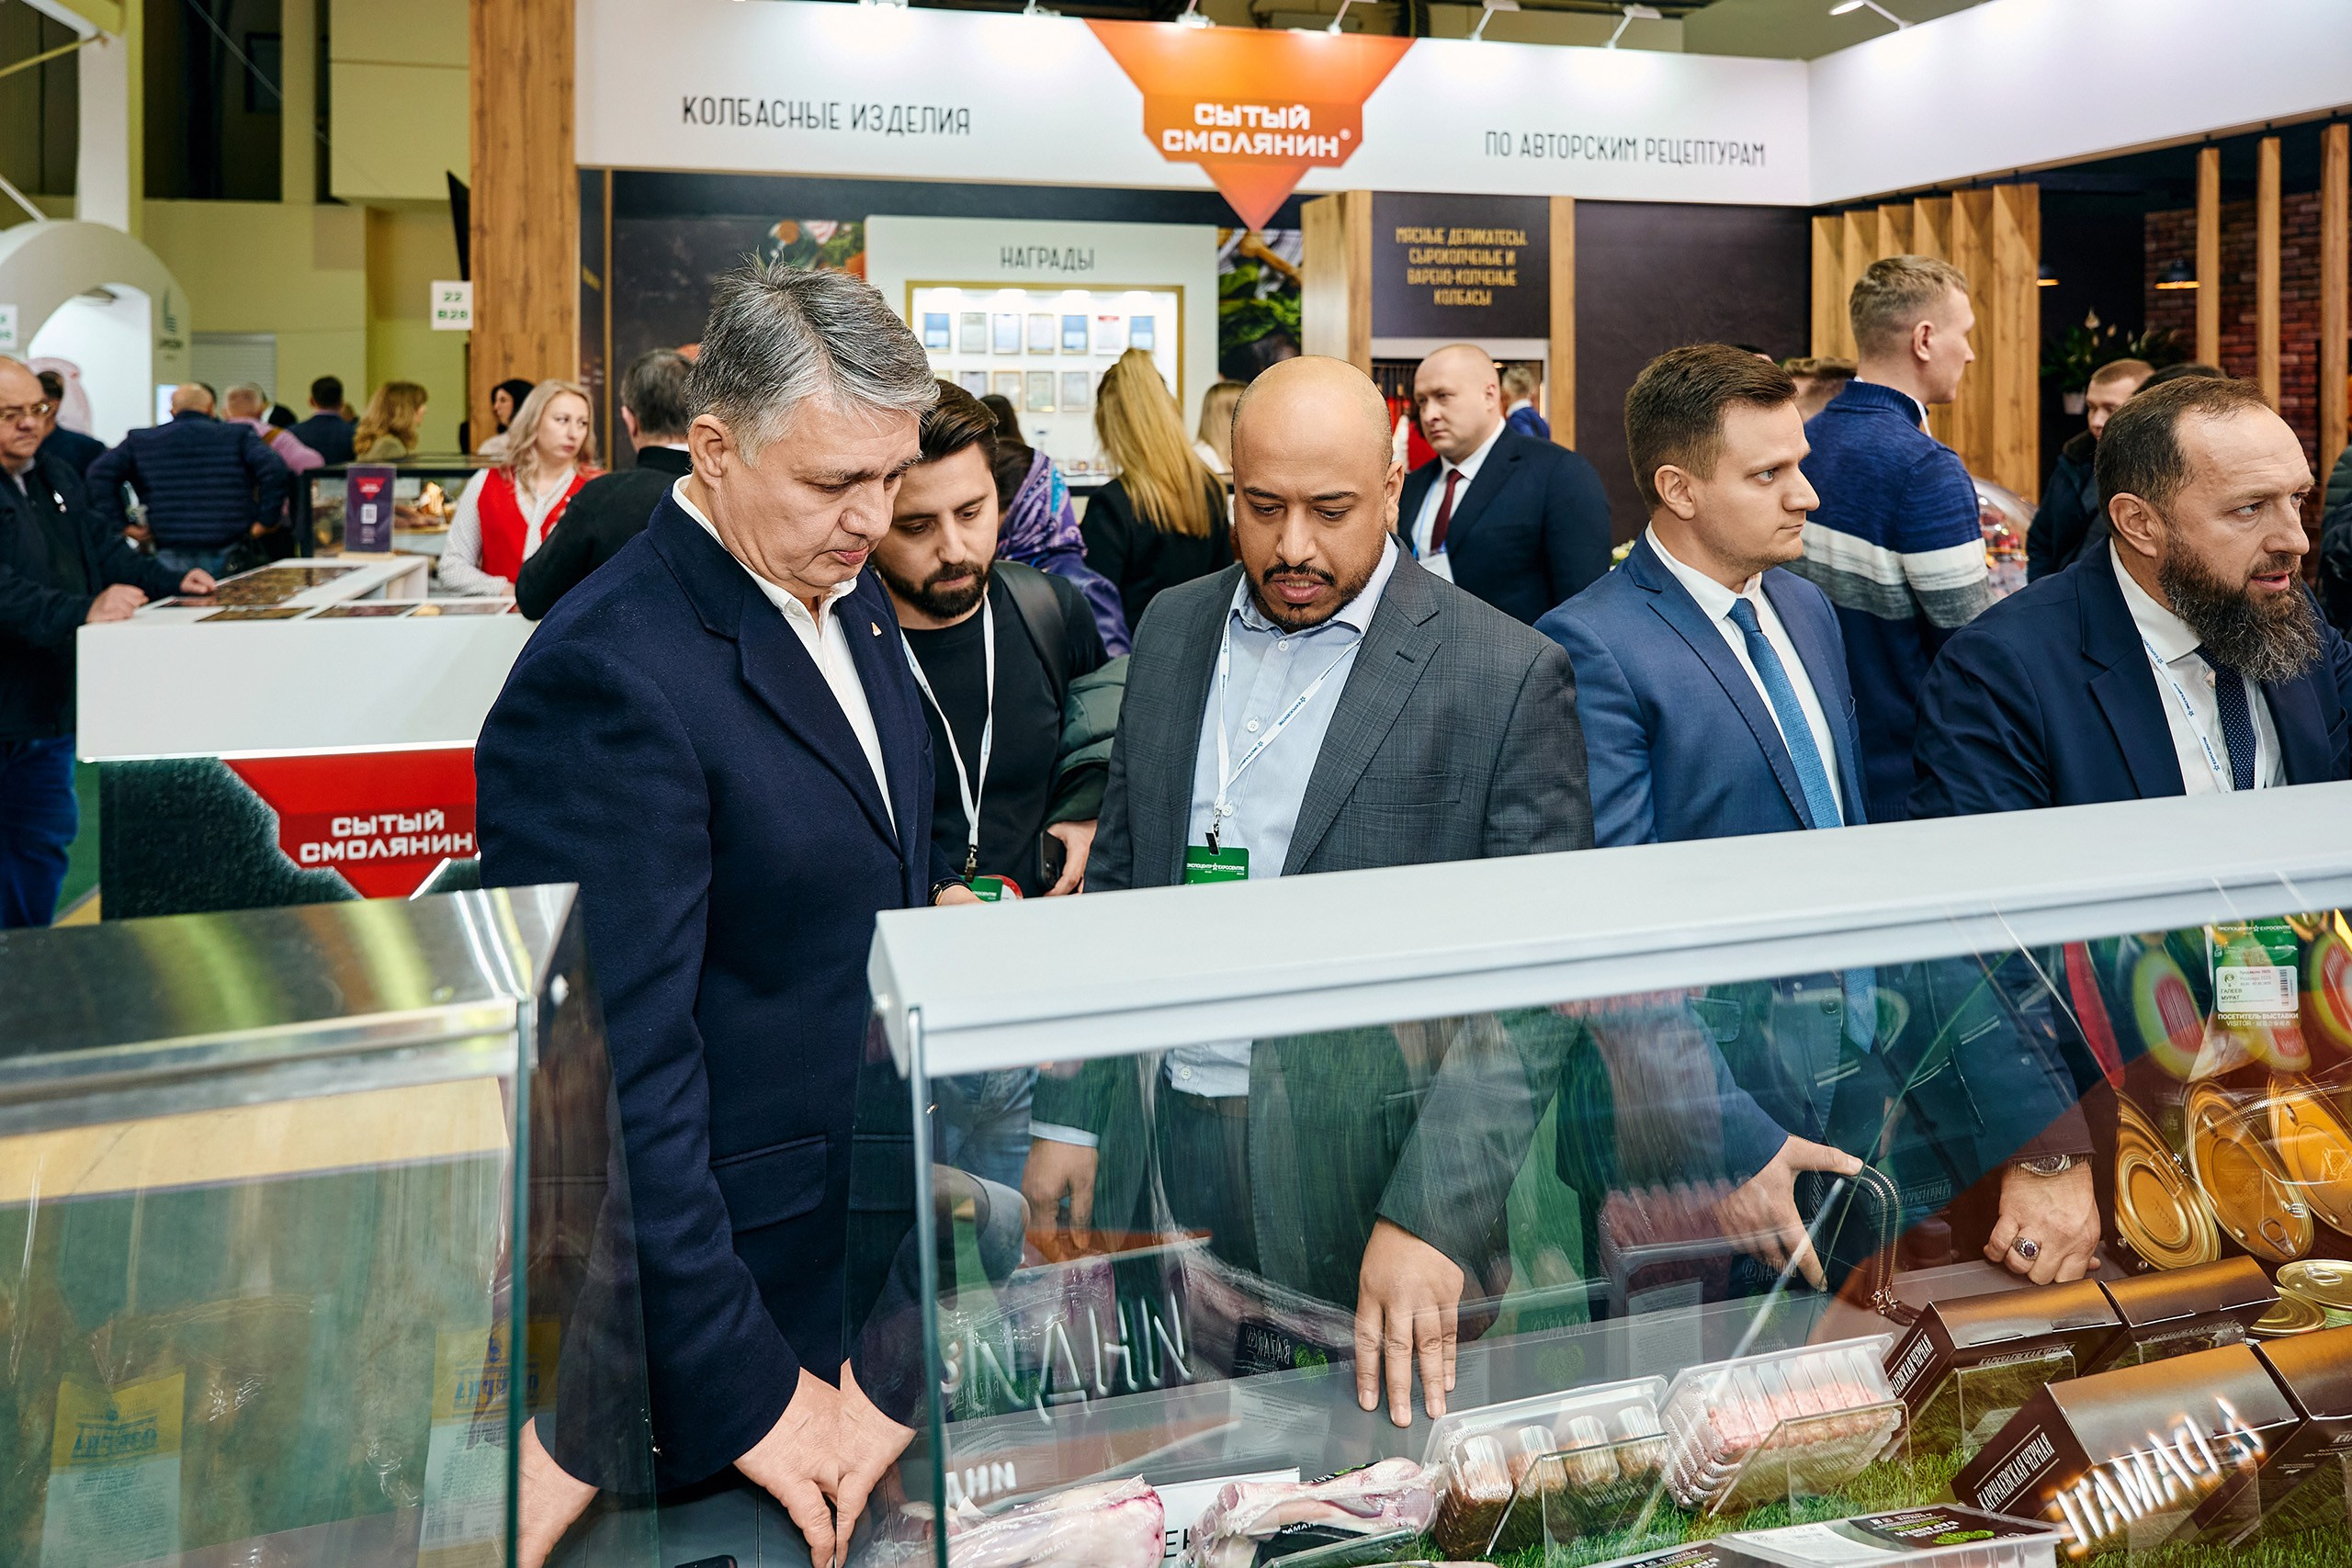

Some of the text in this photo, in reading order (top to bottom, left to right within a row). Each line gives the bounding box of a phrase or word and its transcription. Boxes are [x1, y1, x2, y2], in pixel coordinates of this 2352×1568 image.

[683, 96, 971, 137] КОЛБАСНЫЕ ИЗДЕЛИЯ
[1193, 102, 1311, 130] СЫТЫЙ
[1162, 129, 1340, 158] СМОЛЯНИН
[1485, 130, 1766, 167] ПО АВТОРСКИМ РЕЦЕПТУРАМ
[1395, 226, 1446, 245] МЯСНЫЕ
[1000, 246, 1095, 274] НАГРАДЫ
[1408, 247, 1516, 266] СЫРОКОПЧЕНЫЕ И
[443, 290, 463, 302] 22
[1433, 288, 1493, 307] КОЛБАСЫ
[331, 808, 445, 838] СЫТЫЙ
[300, 832, 473, 863] СМОЛЯНИН
[1889, 1333, 1935, 1396] ЧАЕВСКАЯ ЧЕРНАЯ
[1976, 1431, 2056, 1512] КАРАЧАЕВСКАЯ ЧЕРНАЯ
[1366, 1519, 1408, 1530] DAMATE
[1030, 1538, 1073, 1562] DAMATE
